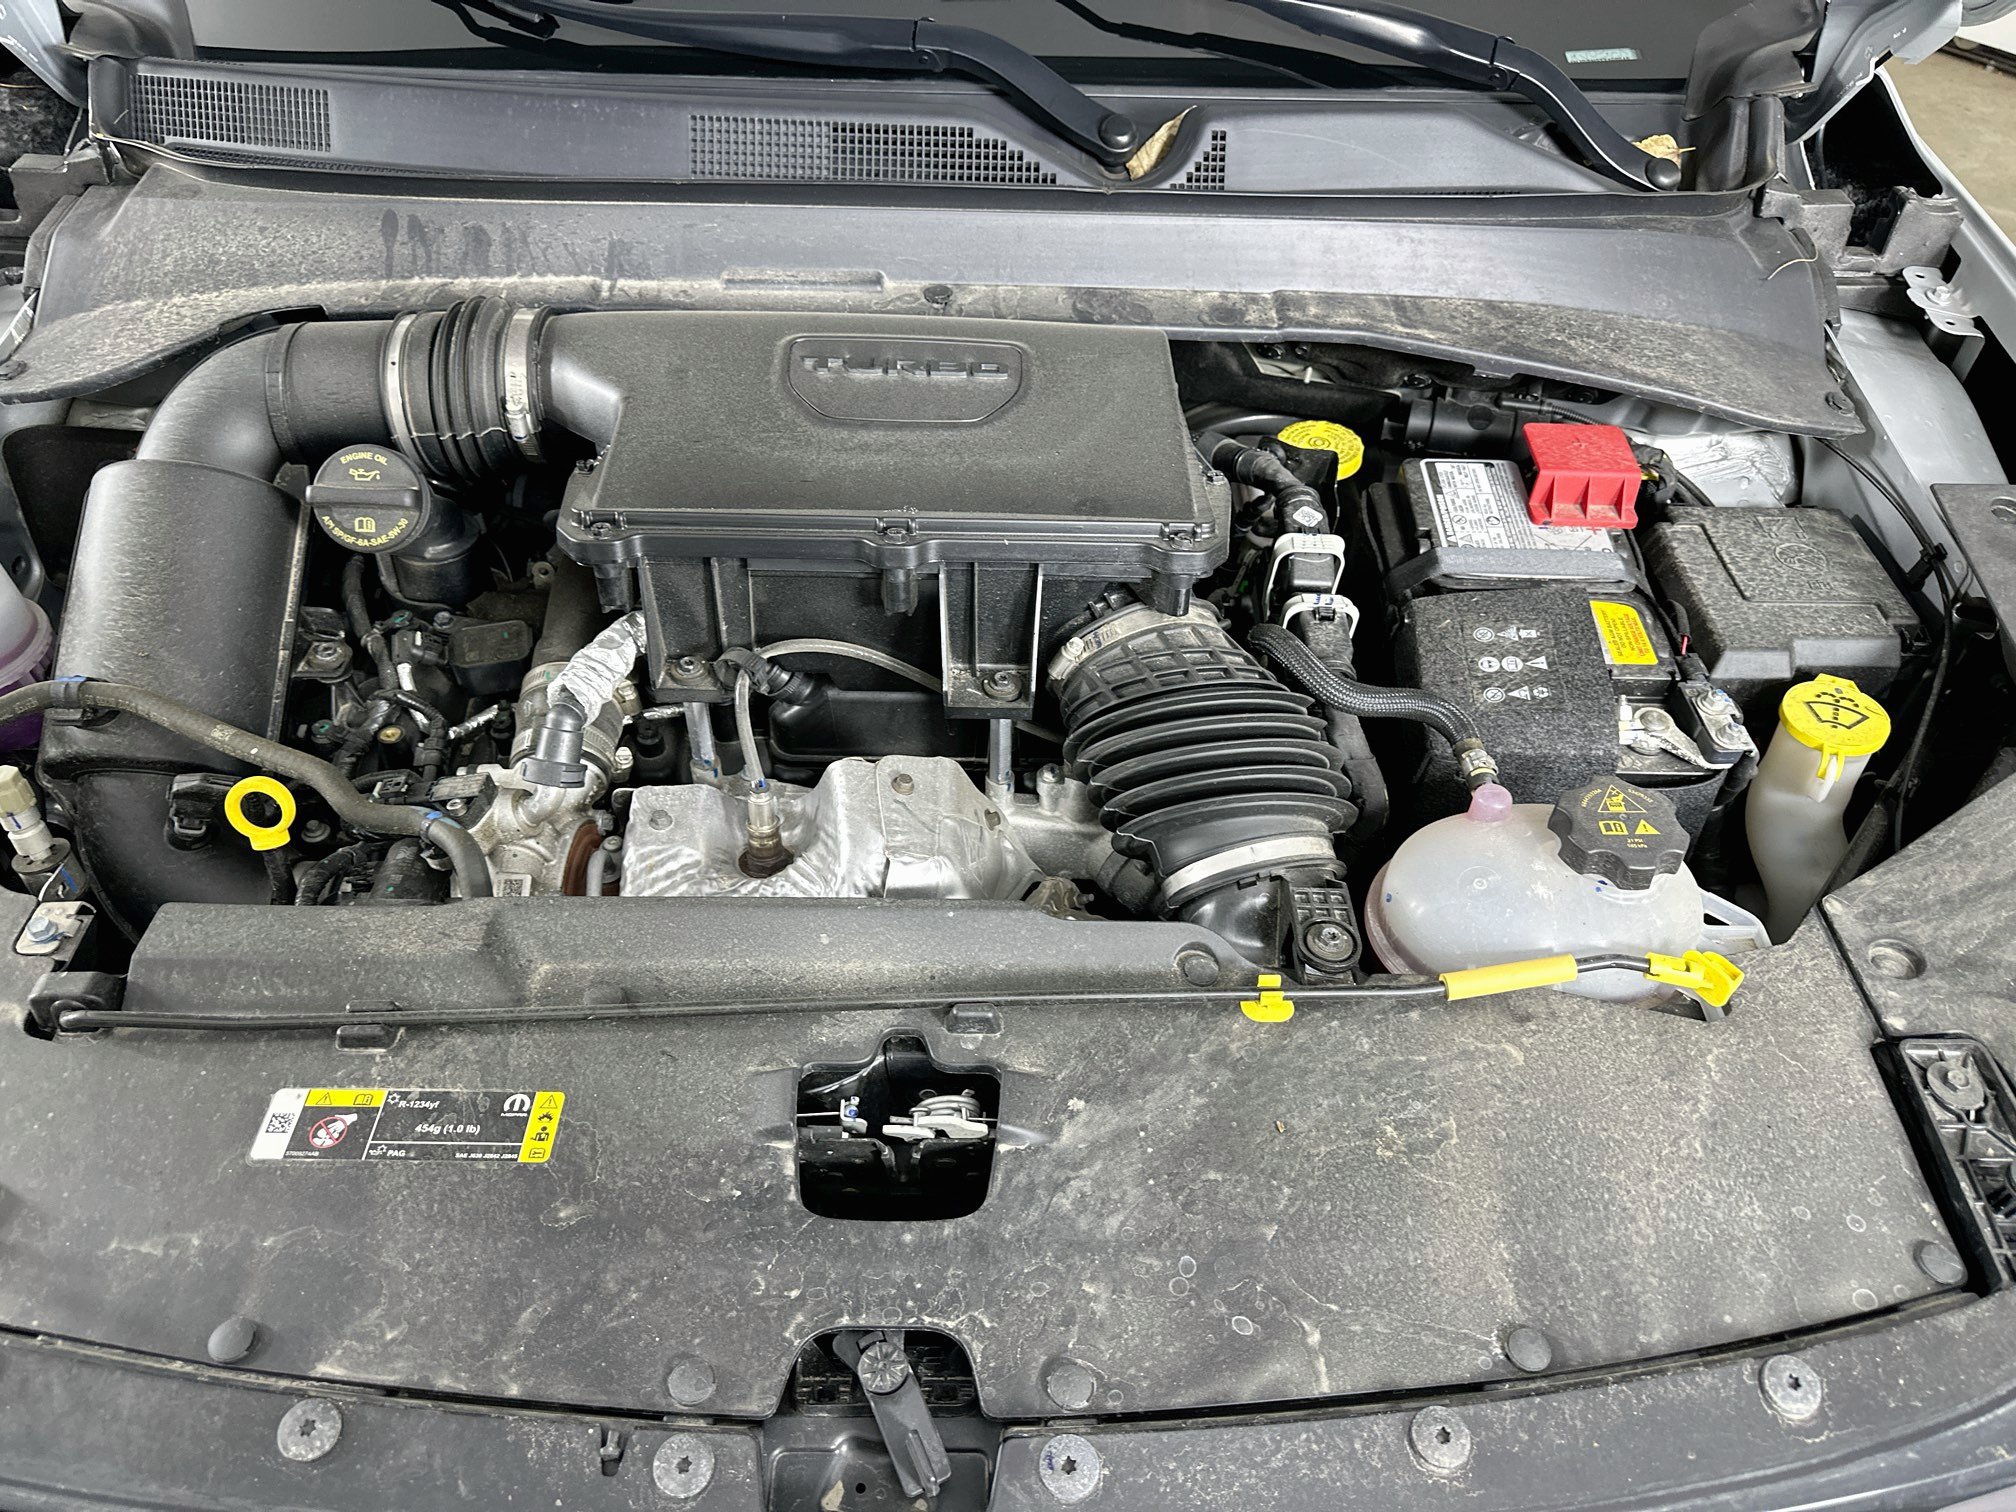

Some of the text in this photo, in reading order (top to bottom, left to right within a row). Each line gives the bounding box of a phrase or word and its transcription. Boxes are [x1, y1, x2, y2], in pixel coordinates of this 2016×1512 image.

[803, 357, 1008, 378] TURBO
[340, 451, 388, 465] ENGINE OIL
[322, 516, 335, 529] API
[398, 1101, 440, 1109] R-1234yf
[415, 1124, 481, 1135] 454g (1.0 lb)
